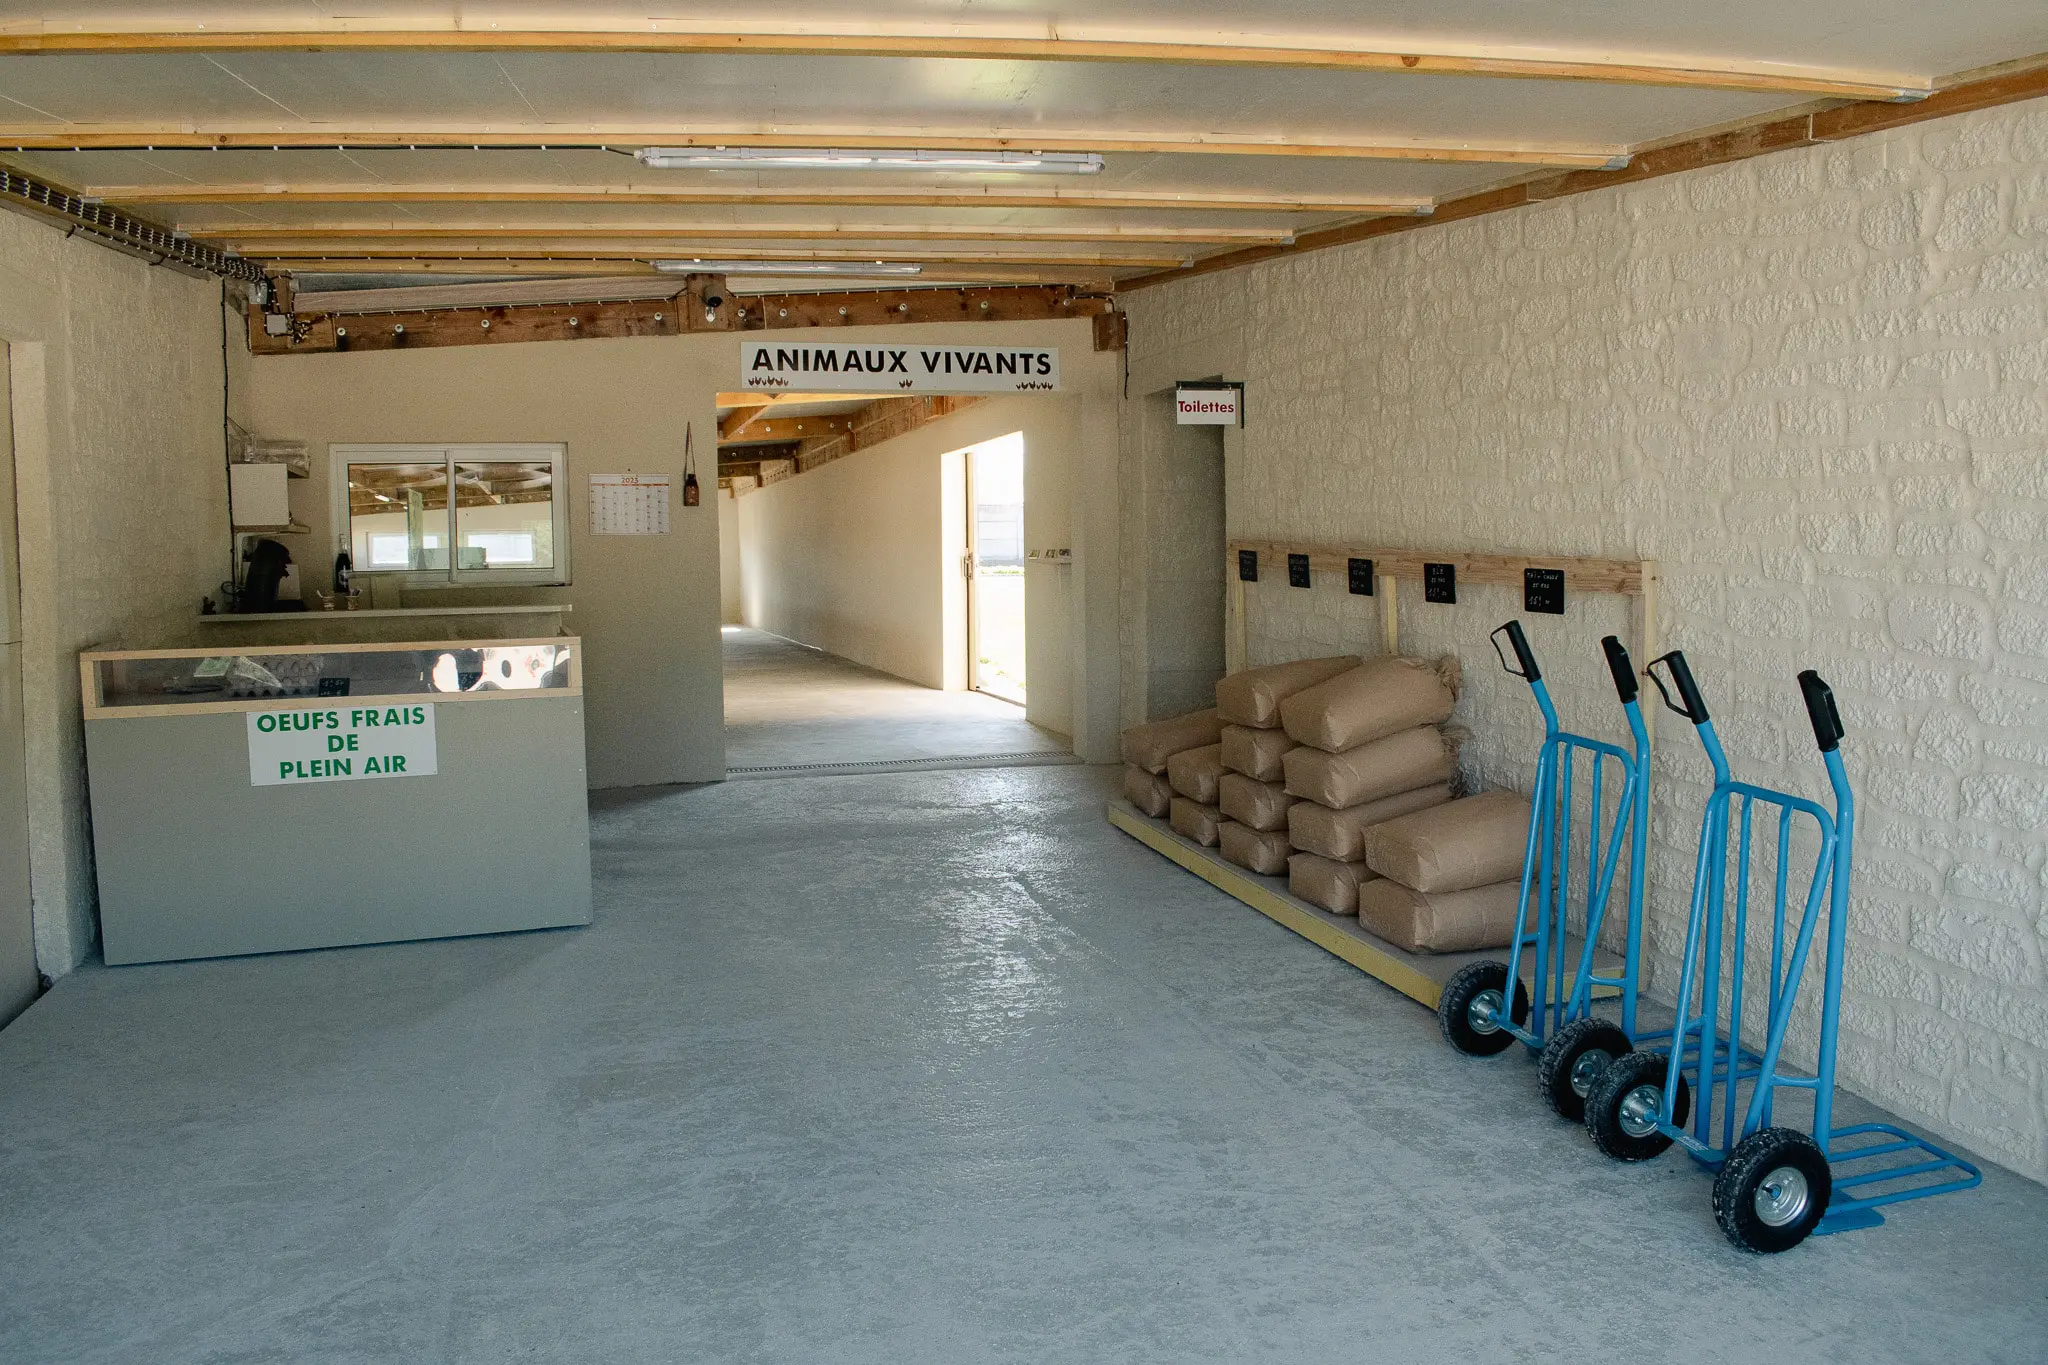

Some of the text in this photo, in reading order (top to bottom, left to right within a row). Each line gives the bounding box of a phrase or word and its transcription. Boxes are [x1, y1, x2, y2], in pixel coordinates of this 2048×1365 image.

[752, 348, 1052, 375] ANIMAUX VIVANTS
[1178, 400, 1235, 413] Toilettes
[257, 706, 426, 733] OEUFS FRAIS
[327, 733, 359, 753] DE
[280, 755, 408, 779] PLEIN AIR
